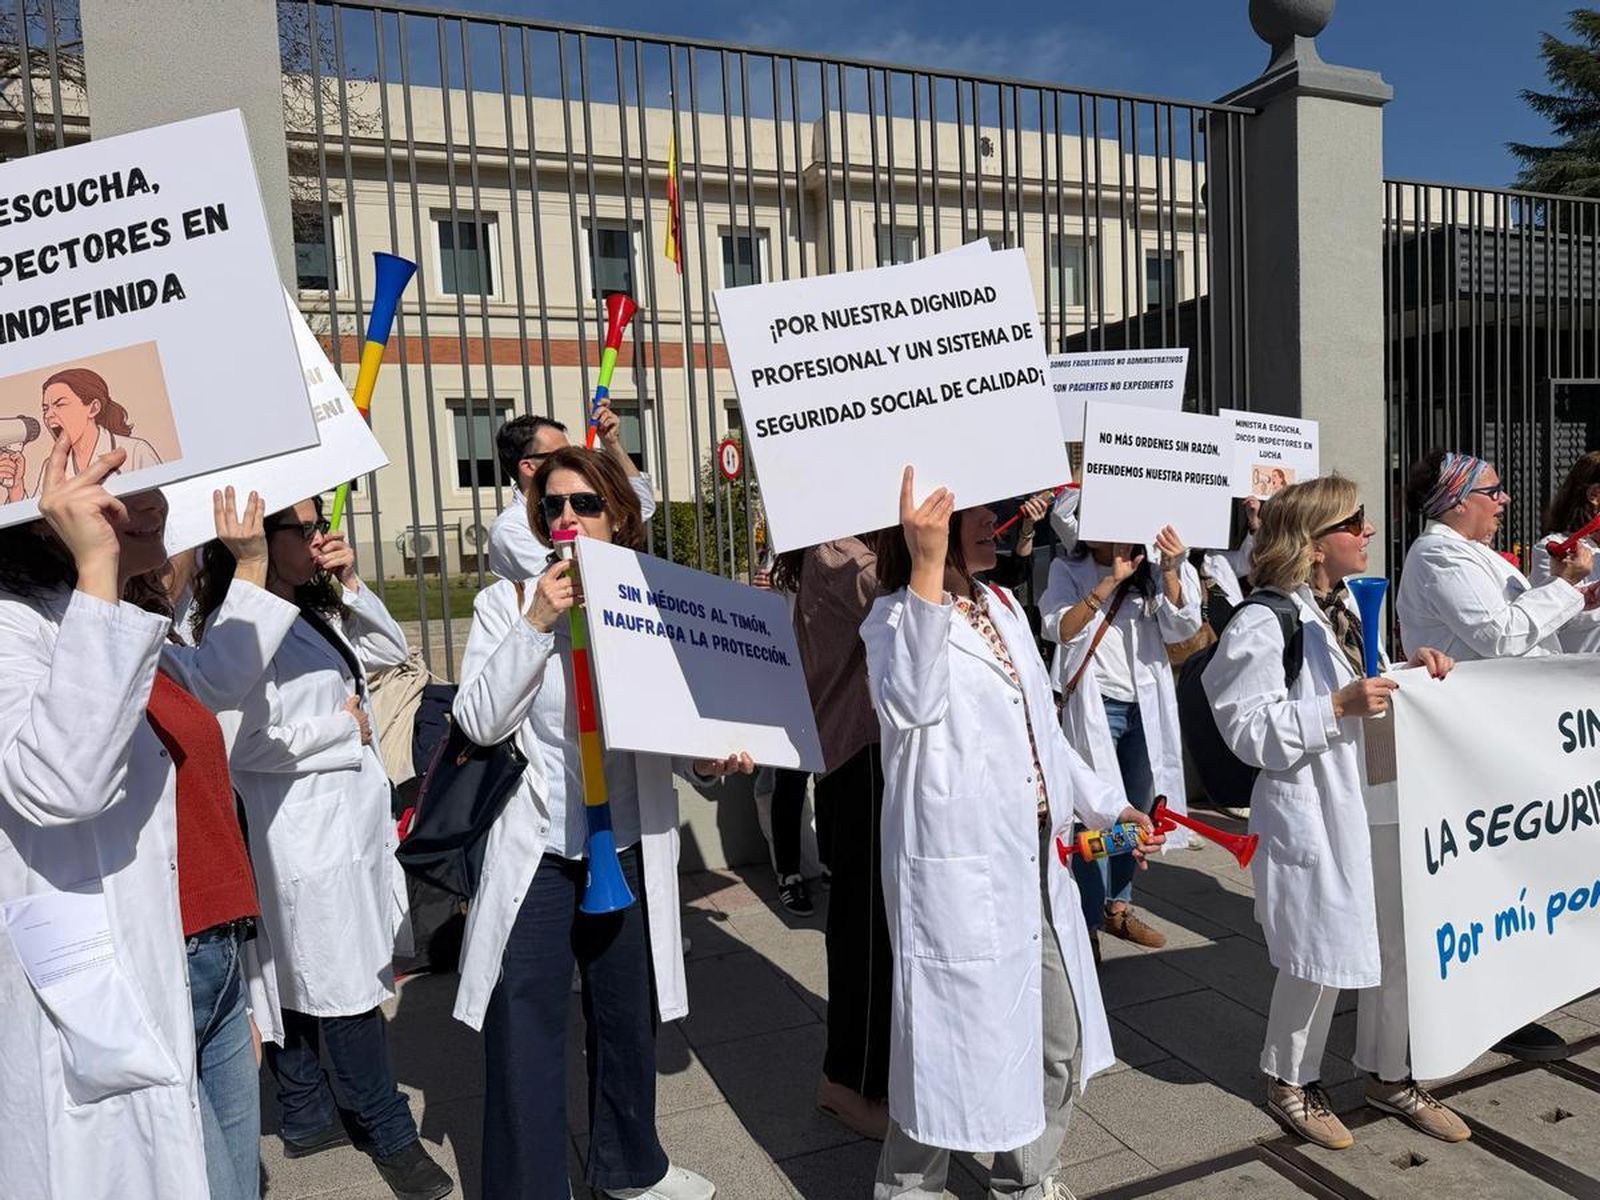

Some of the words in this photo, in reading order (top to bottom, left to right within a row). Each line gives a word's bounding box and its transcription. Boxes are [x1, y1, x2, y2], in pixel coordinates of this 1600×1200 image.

[182, 203, 229, 240] EN
[769, 314, 819, 344] ¡POR
[822, 300, 908, 331] NUESTRA
[910, 286, 997, 315] DIGNIDAD
[751, 349, 887, 388] PROFESIONAL
[888, 346, 902, 363] Y
[905, 339, 933, 360] UN
[937, 328, 1010, 355] SISTEMA
[1013, 323, 1033, 341] DE
[1072, 359, 1115, 367] FACULTATIVOS
[1127, 356, 1183, 365] ADMINISTRATIVOS
[1053, 384, 1067, 392] SON
[1068, 382, 1108, 392] PACIENTES
[1110, 382, 1120, 391] NO
[1123, 380, 1174, 390] EXPEDIENTES
[755, 402, 866, 438] SEGURIDAD
[871, 387, 938, 416] SOCIAL
[941, 381, 963, 399] DE
[1235, 419, 1267, 431] MINISTRA
[1099, 432, 1112, 444] NO
[1114, 432, 1133, 446] MÁS
[1135, 436, 1173, 450] ORDENES
[1175, 440, 1189, 452] SIN
[1257, 436, 1302, 449] INSPECTORES
[1303, 441, 1313, 450] EN
[1259, 450, 1282, 460] LUCHA
[1087, 462, 1143, 478] DEFENDEMOS
[1145, 467, 1182, 482] NUESTRA
[618, 583, 641, 604] SIN
[647, 590, 706, 619] MÉDICOS
[711, 607, 728, 625] AL
[603, 609, 686, 643] NAUFRAGA
[689, 629, 709, 649] LA
[712, 635, 791, 666] PROTECCIÓN.
[1424, 818, 1458, 876] LA
[1494, 887, 1535, 941] mí,
